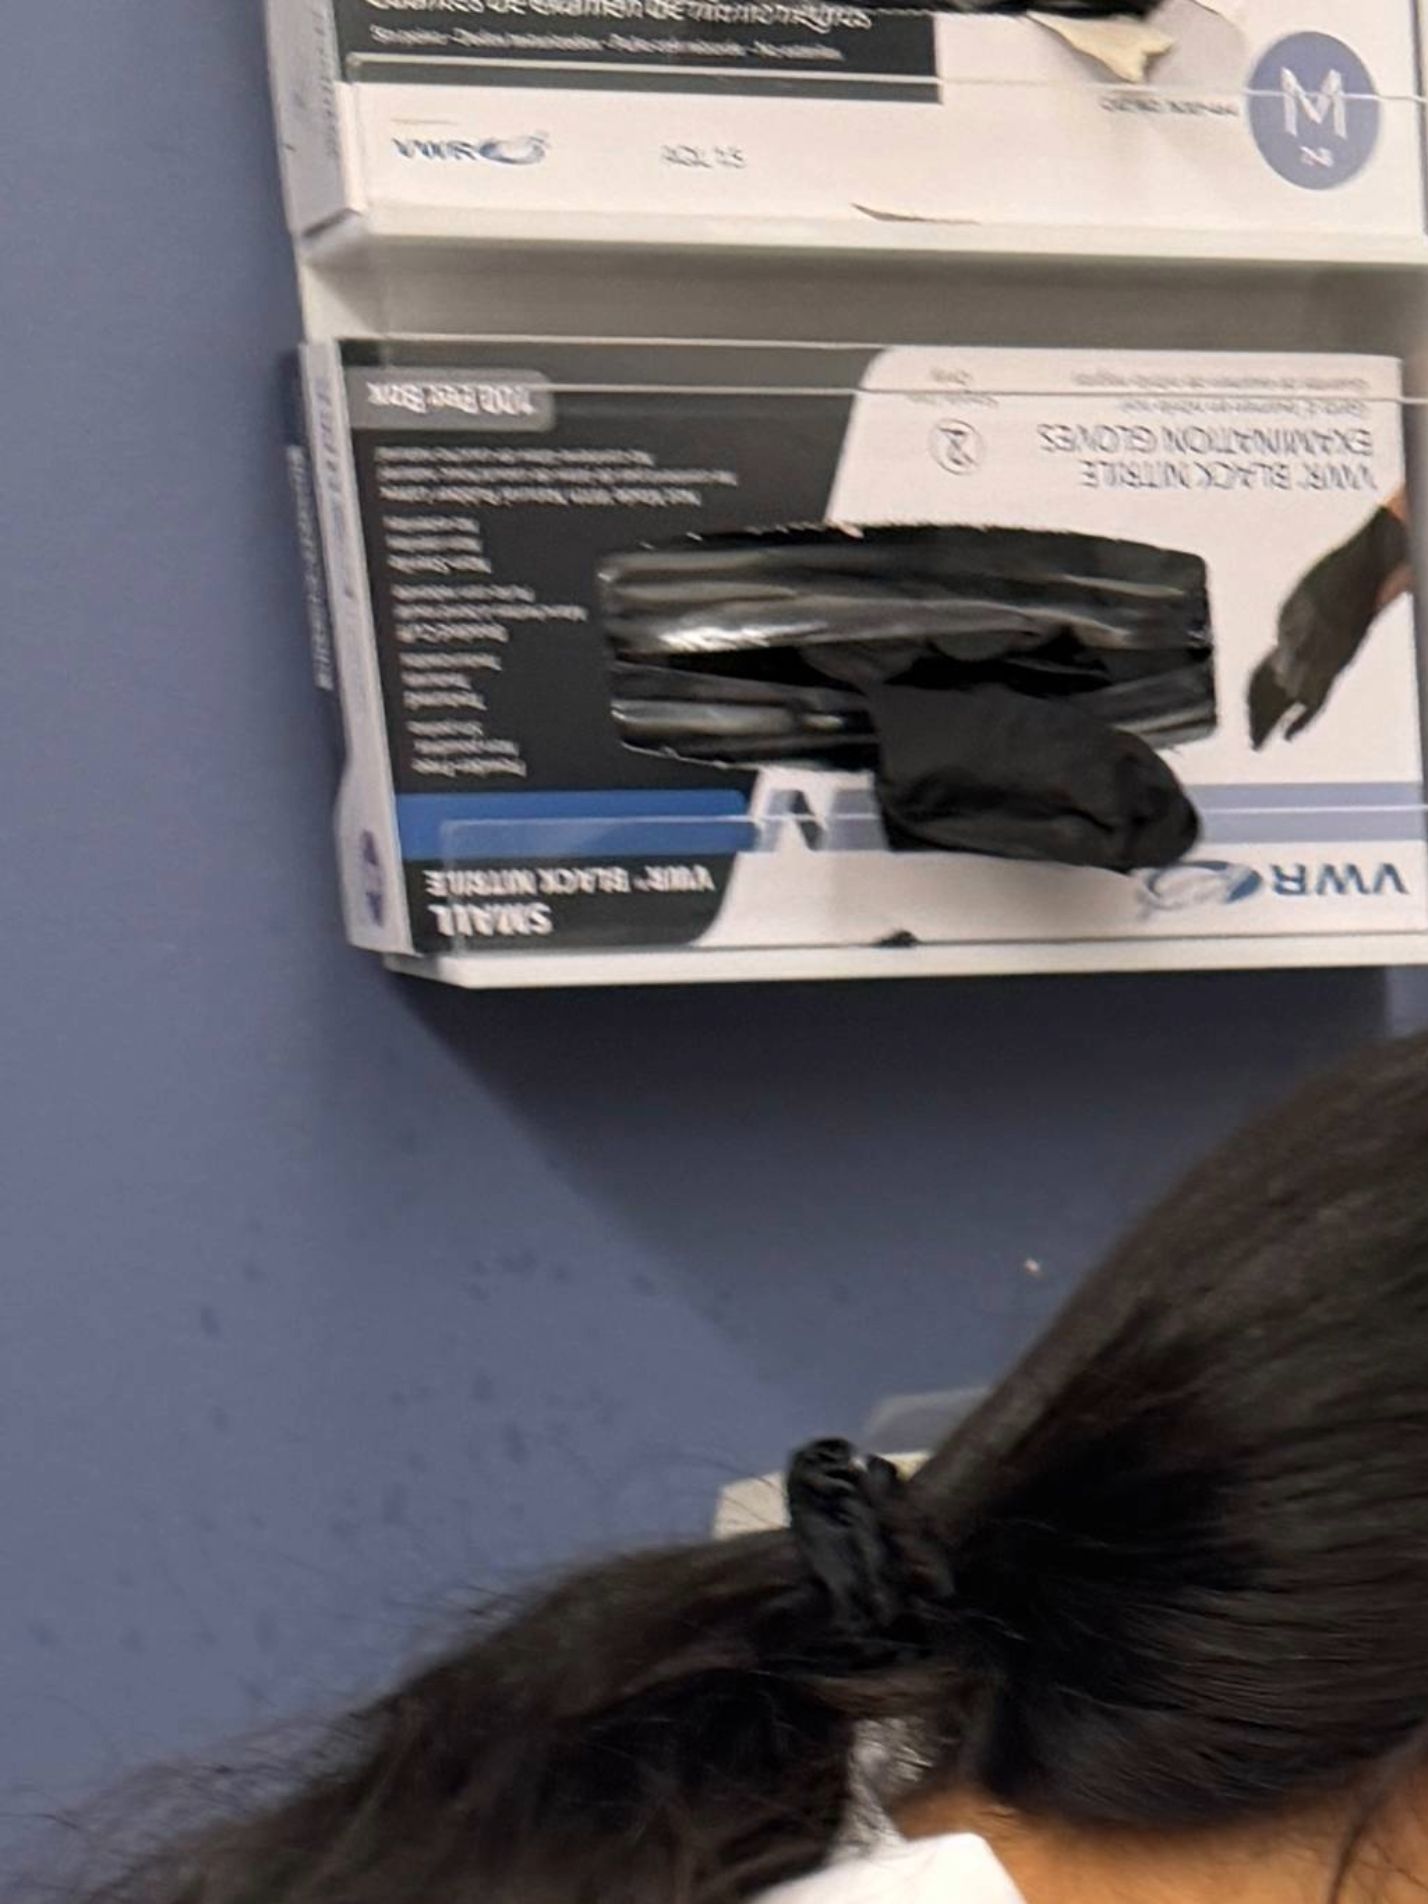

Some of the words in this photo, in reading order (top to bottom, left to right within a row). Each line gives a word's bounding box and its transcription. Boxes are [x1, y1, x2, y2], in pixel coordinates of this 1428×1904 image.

[1280, 66, 1347, 139] M
[1038, 423, 1160, 454] GLOVES
[1167, 425, 1374, 456] EXAMINATION
[1079, 459, 1190, 489] NITRILE
[1197, 460, 1292, 491] BLACK
[422, 867, 537, 896] NITRILE
[538, 866, 631, 893] BLACK
[1269, 861, 1410, 897] VWR
[427, 902, 555, 936] SMALL
